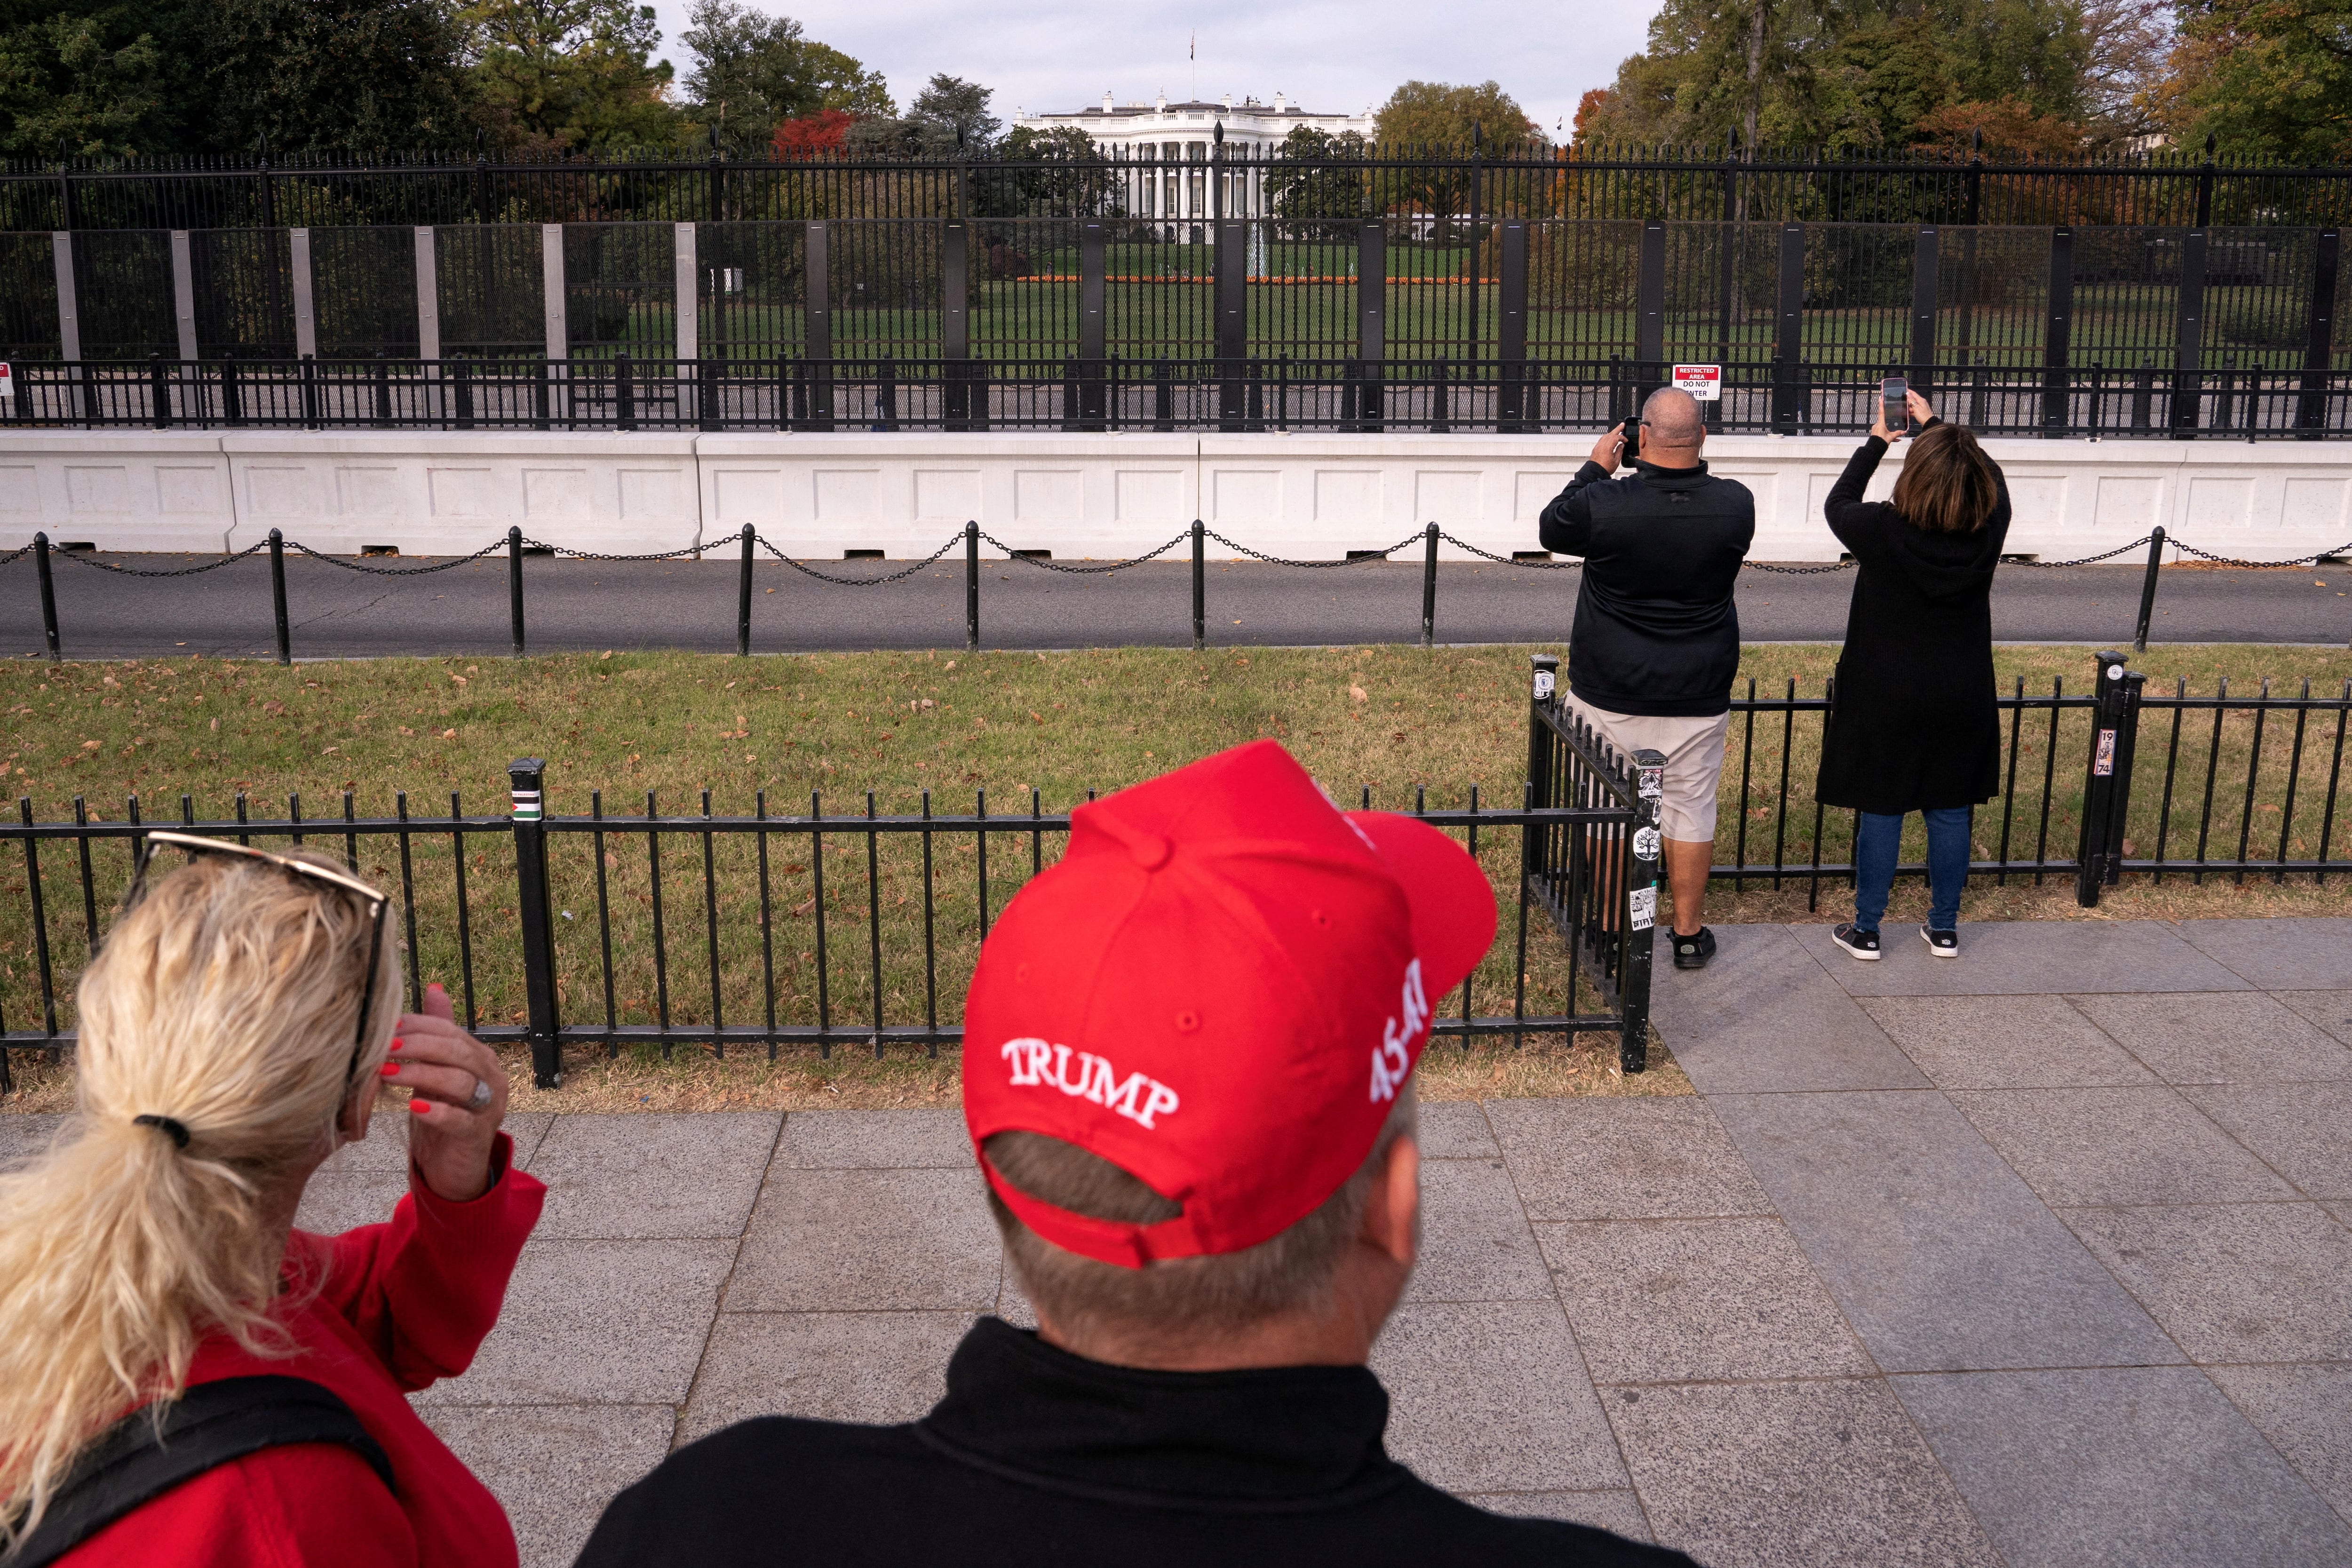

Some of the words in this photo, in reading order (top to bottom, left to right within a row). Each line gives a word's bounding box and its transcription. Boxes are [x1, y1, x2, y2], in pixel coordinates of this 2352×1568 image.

[2102, 732, 2113, 741] 19
[2098, 764, 2110, 773] 74
[1369, 957, 1428, 1104] 45-47
[1000, 1037, 1180, 1130] TRUMP
